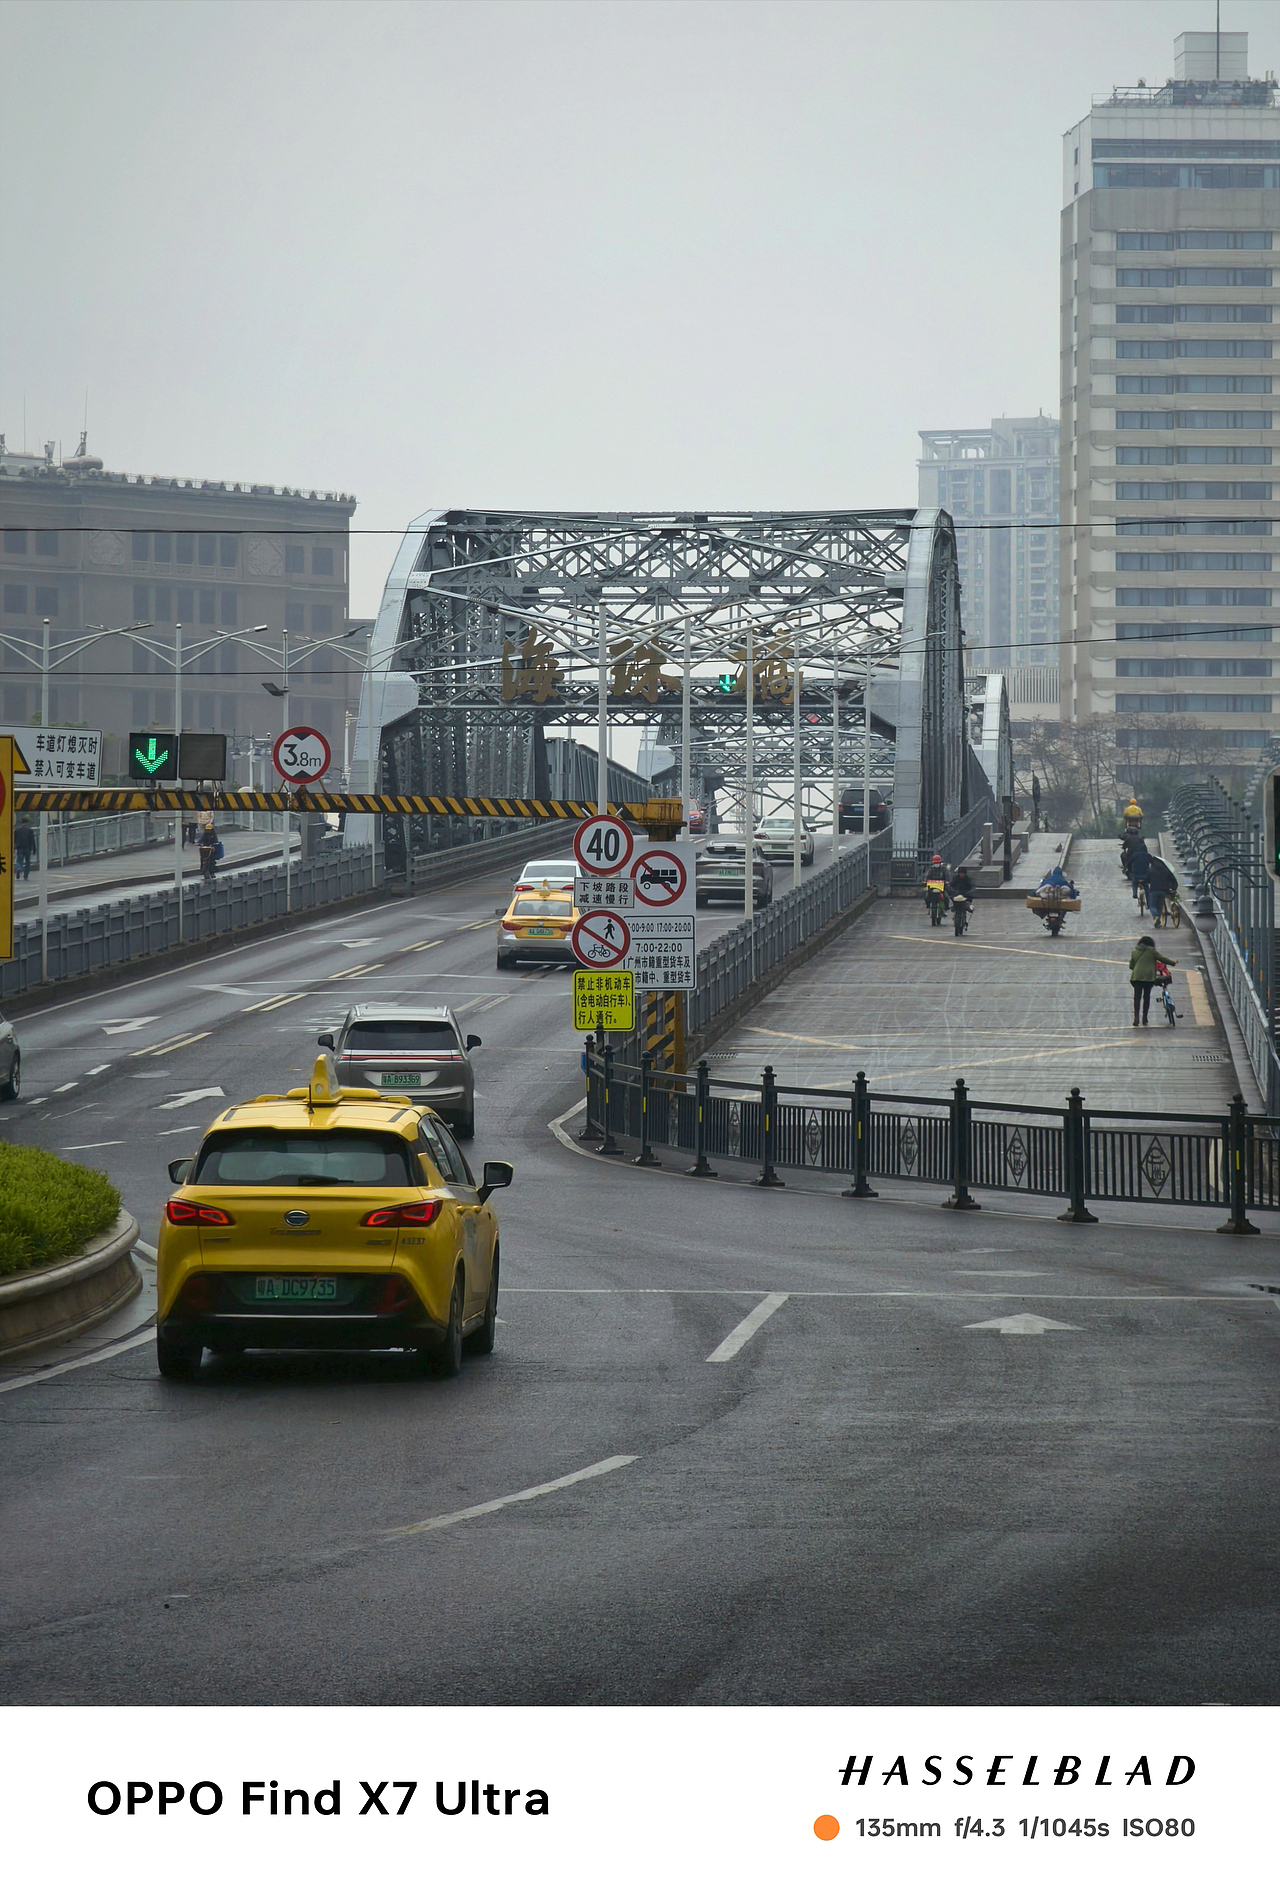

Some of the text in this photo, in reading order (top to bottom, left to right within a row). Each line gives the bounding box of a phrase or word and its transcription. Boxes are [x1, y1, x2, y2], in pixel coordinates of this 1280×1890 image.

[36, 734, 98, 755] 车道灯熄灭时
[283, 743, 322, 767] 3.8m
[34, 759, 96, 780] 禁入可变车道
[586, 828, 620, 862] 40
[580, 882, 629, 893] 下坡路段
[579, 894, 629, 905] 减速慢行
[628, 922, 691, 932] :00-9:00 17:00-20:00
[636, 943, 682, 952] 7:00-22:00
[627, 956, 691, 968] 广州市籍重型货车及
[578, 977, 631, 991] 禁止非机动车
[578, 1010, 617, 1025] 行人通行。
